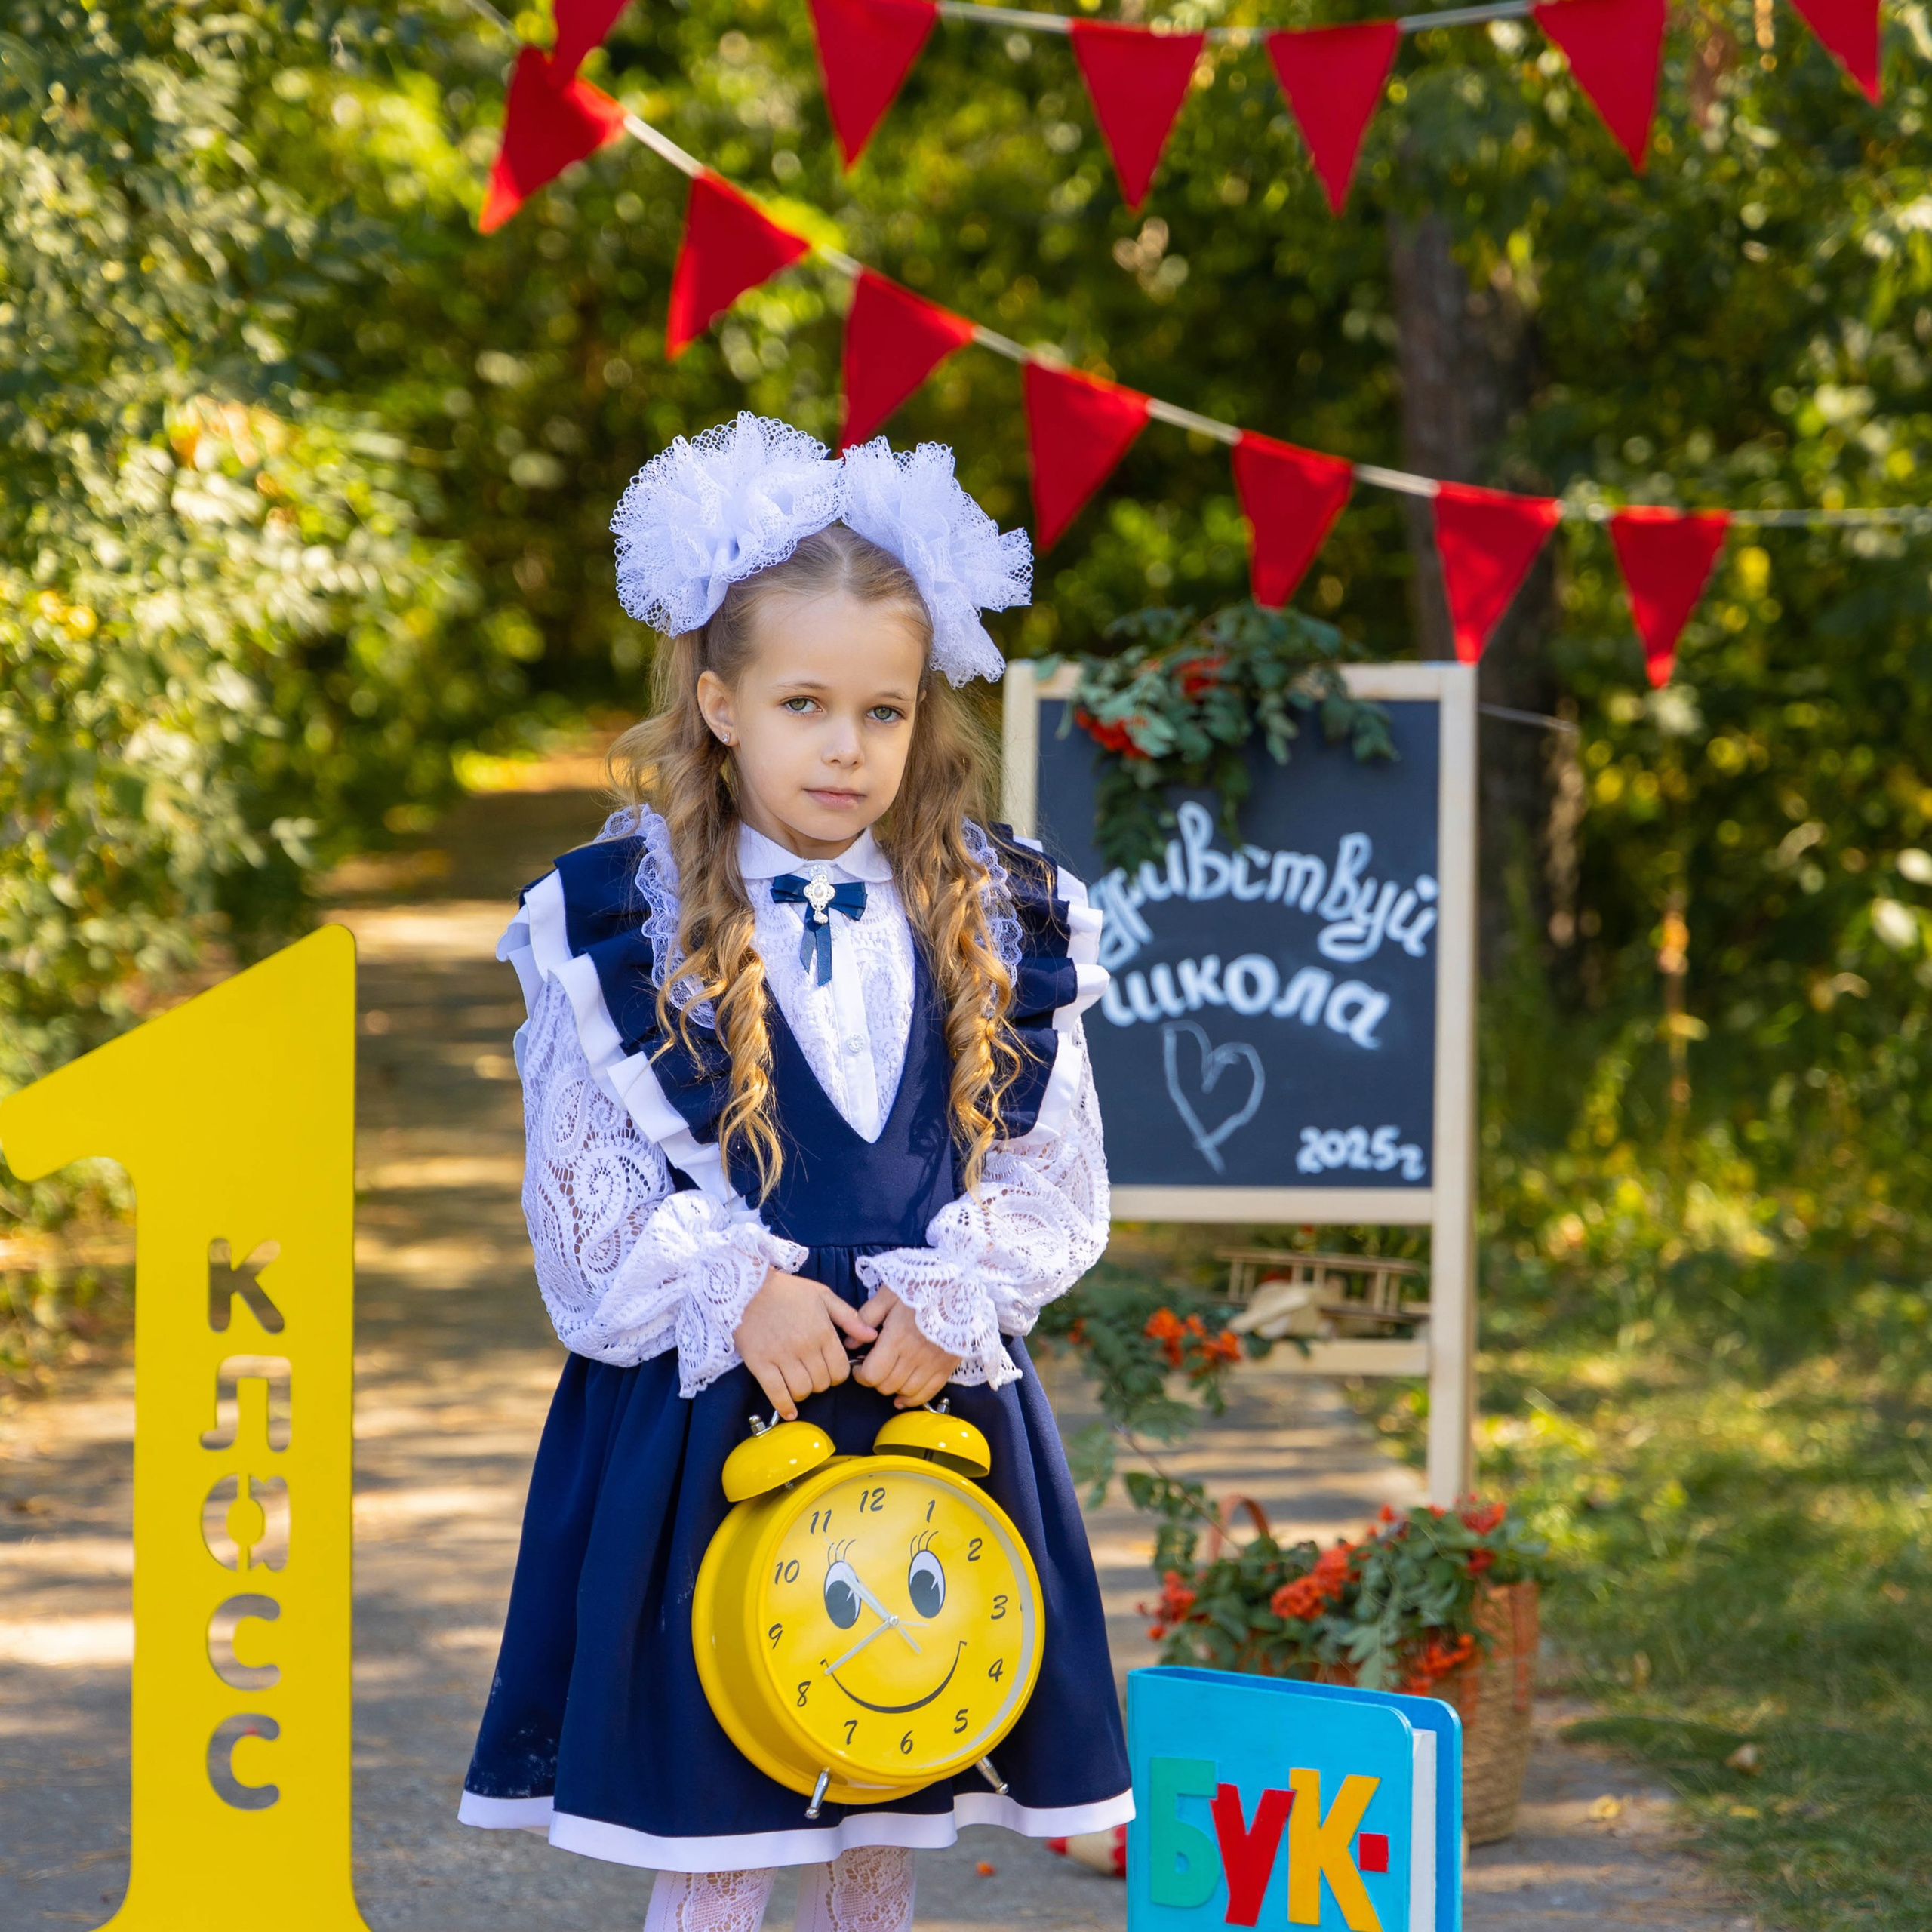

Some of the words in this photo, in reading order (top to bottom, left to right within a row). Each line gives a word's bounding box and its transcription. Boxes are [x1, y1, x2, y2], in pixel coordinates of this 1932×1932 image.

[1101, 953, 1389, 1050] школа
[860, 1487, 886, 1512] 12
[926, 1500, 935, 1523] 1
[810, 1509, 832, 1534] 11
[967, 1537, 983, 1562] 2
[774, 1559, 799, 1584] 10
[990, 1595, 1008, 1620] 3
[768, 1623, 783, 1649] 9
[988, 1658, 1003, 1683] 4
[796, 1681, 812, 1708] 8
[843, 1719, 858, 1746] 7
[953, 1709, 968, 1734] 5
[900, 1730, 913, 1755] 6
